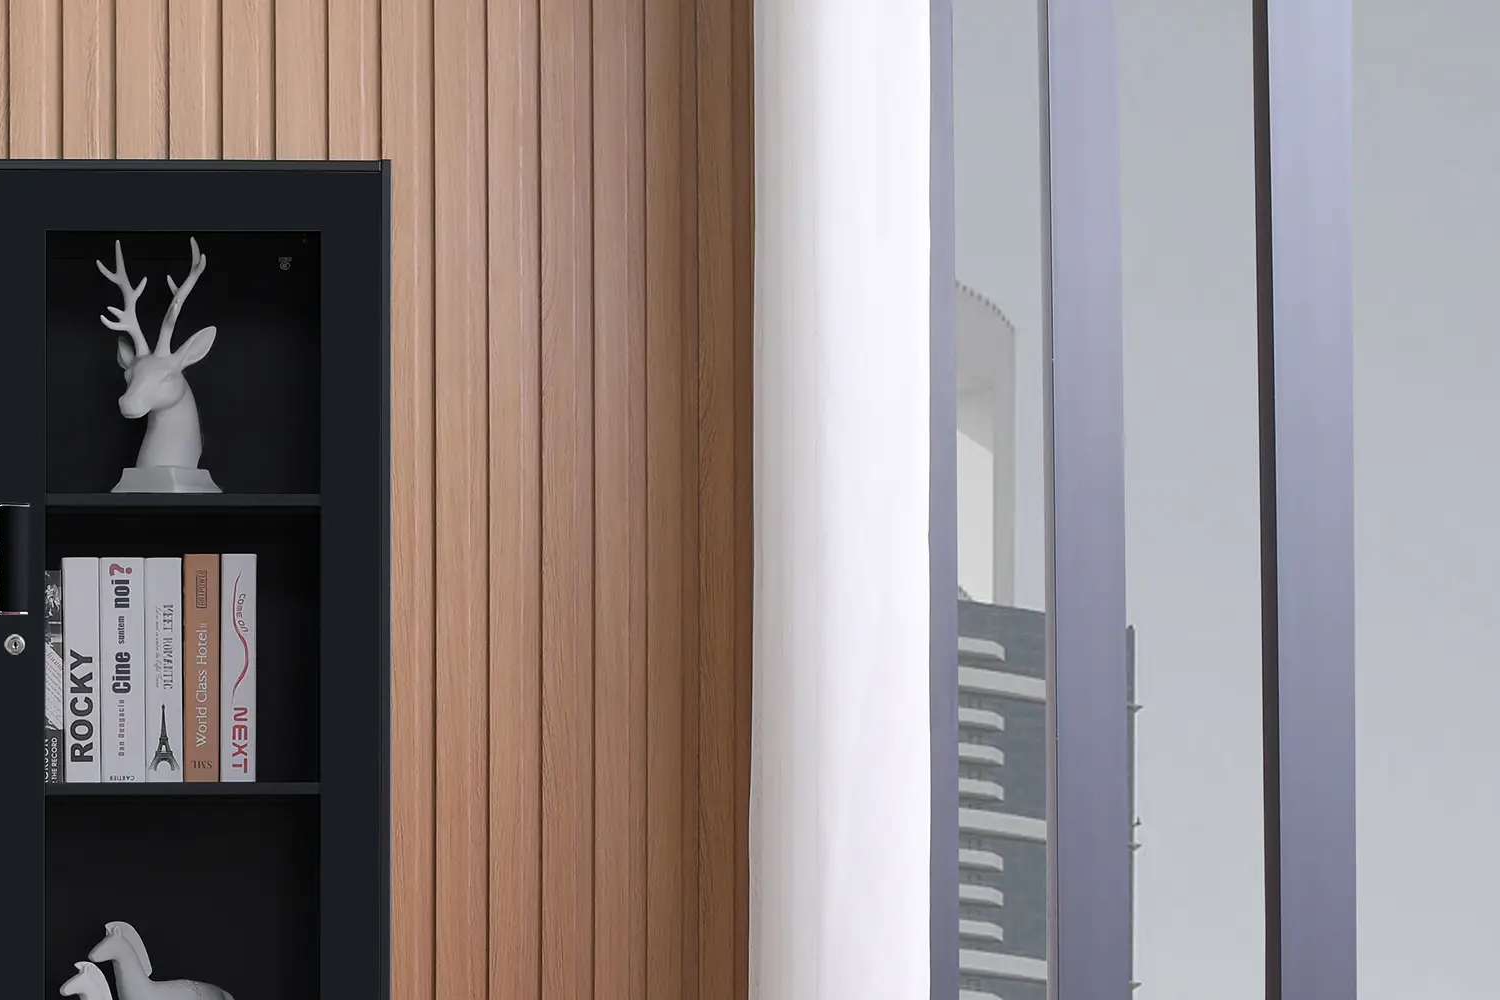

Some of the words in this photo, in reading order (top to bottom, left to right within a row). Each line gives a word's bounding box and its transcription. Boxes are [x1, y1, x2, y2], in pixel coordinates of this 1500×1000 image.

[197, 569, 206, 606] ARTPOWER
[162, 637, 174, 690] ROMANTIC
[196, 629, 209, 665] Hotel
[111, 651, 132, 694] Cine
[196, 669, 209, 703] Class
[69, 649, 94, 763] ROCKY
[196, 706, 209, 748] World
[231, 706, 249, 774] NEXT
[190, 759, 213, 769] SML
